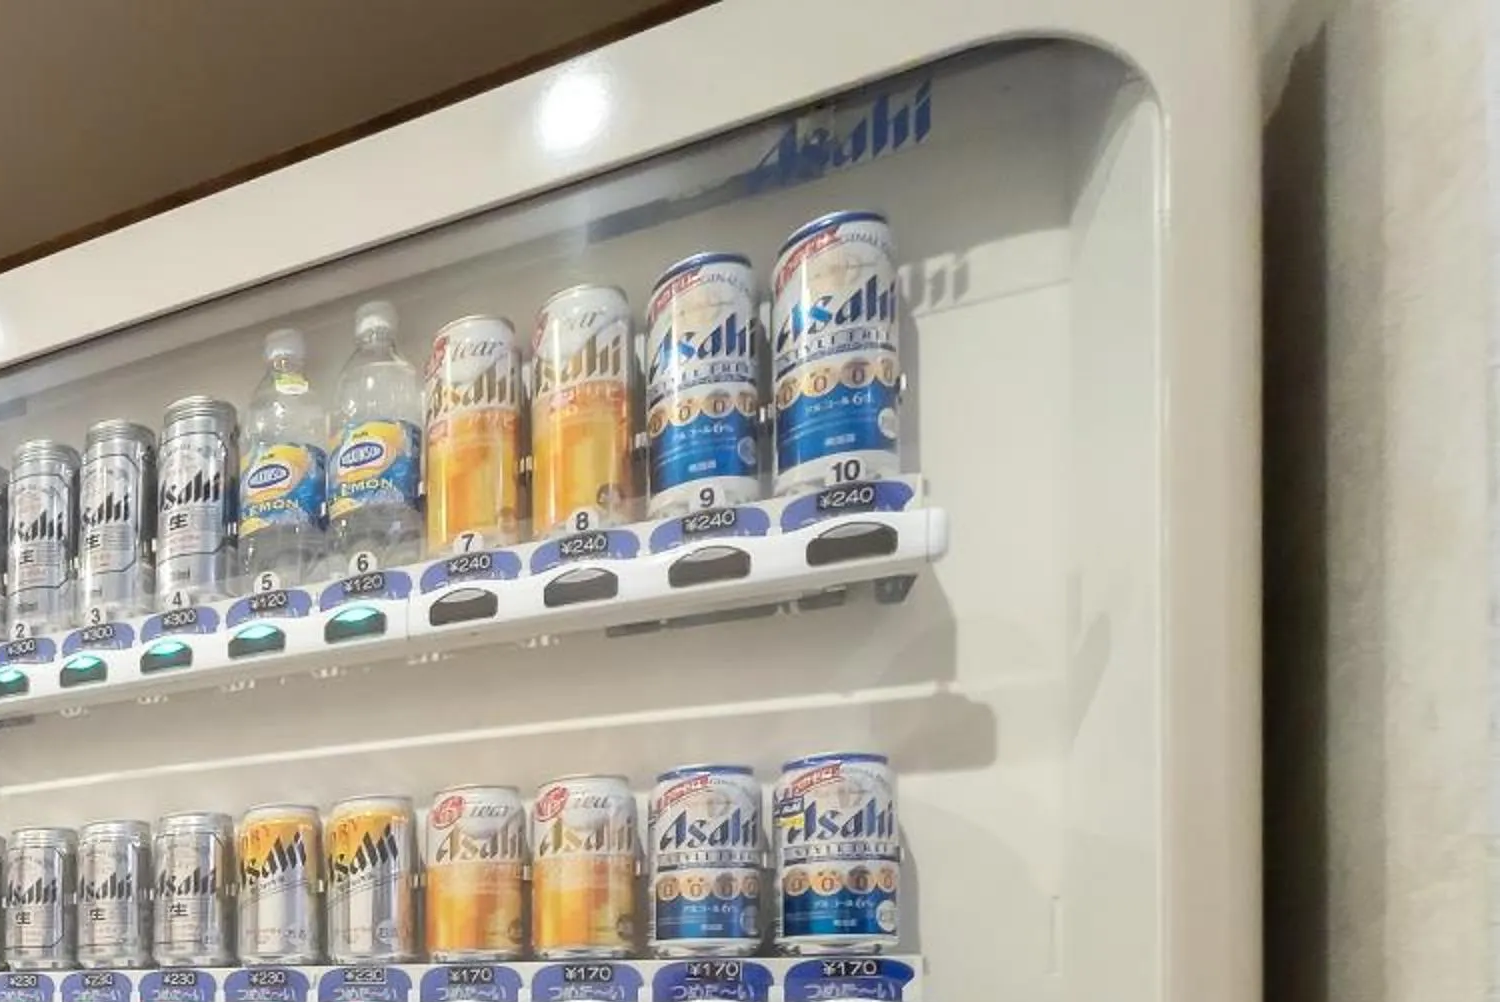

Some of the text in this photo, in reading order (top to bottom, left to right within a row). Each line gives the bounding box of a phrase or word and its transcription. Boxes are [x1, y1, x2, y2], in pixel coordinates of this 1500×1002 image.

[776, 274, 896, 353] Asahi
[648, 312, 756, 386] Asahi
[831, 459, 860, 482] 10
[699, 487, 715, 507] 9
[820, 487, 875, 508] ¥240
[83, 492, 130, 527] sahi
[10, 509, 63, 542] sahi
[575, 512, 589, 531] 8
[684, 510, 736, 529] ¥240
[461, 534, 476, 552] 7
[560, 536, 607, 556] ¥240
[356, 553, 369, 571] 6
[450, 554, 491, 572] ¥240
[261, 573, 273, 590] 5
[171, 591, 183, 606] 4
[91, 607, 102, 624] 3
[15, 623, 26, 639] 2
[659, 807, 758, 850] Asahi
[787, 797, 894, 844] Asahi
[345, 970, 384, 983] ¥230
[450, 968, 492, 983] ¥170
[564, 967, 612, 982] ¥170
[688, 961, 740, 977] ¥170
[823, 960, 878, 976] ¥170
[162, 973, 195, 986] ¥230
[250, 971, 286, 986] ¥230
